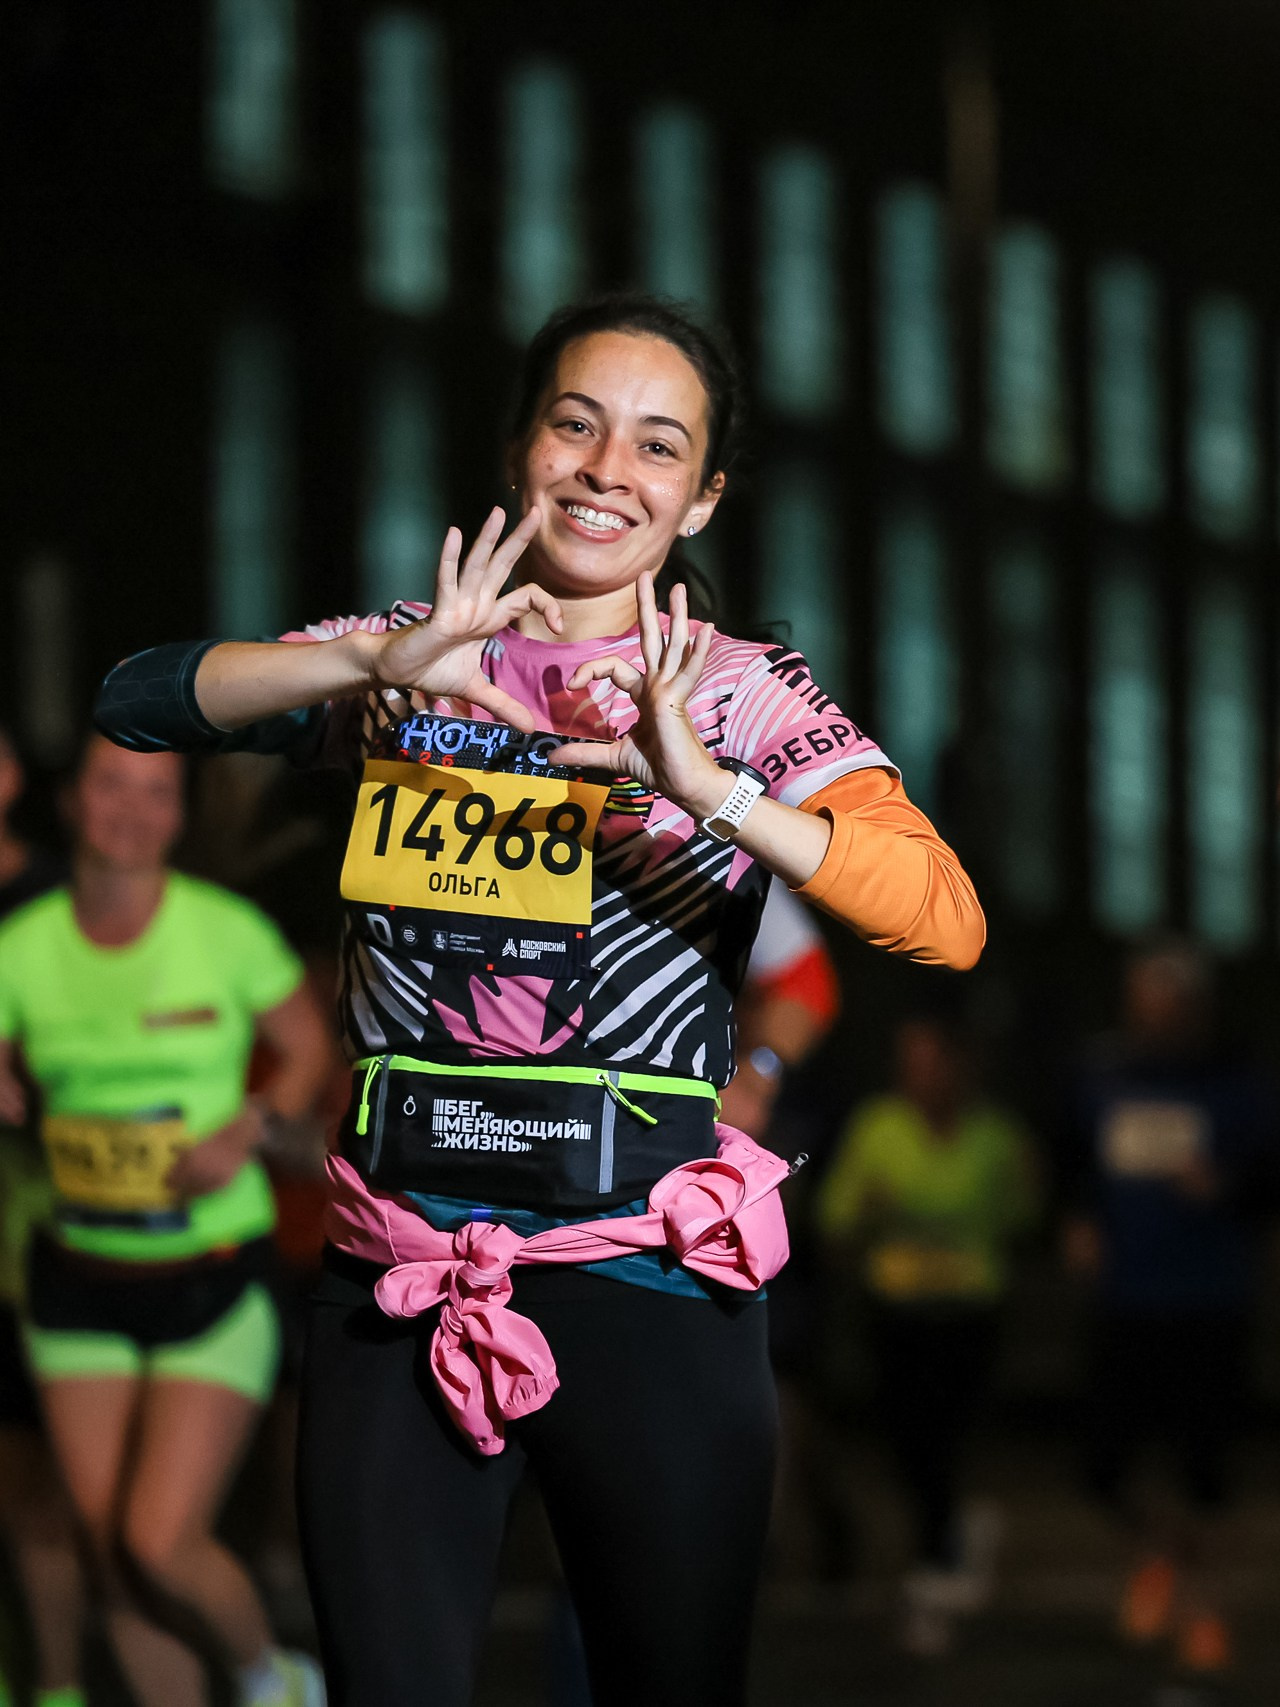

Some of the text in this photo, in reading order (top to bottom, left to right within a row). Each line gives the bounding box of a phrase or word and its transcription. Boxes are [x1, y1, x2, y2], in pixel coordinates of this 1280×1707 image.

[369, 783, 588, 876] 14968
[428, 871, 501, 899] ОЛЬГА
[519, 949, 542, 961] СПОРТ
[520, 939, 567, 953] МОСКОВСКИЙ
[441, 1116, 584, 1141] МЕНЯЮЩИЙ
